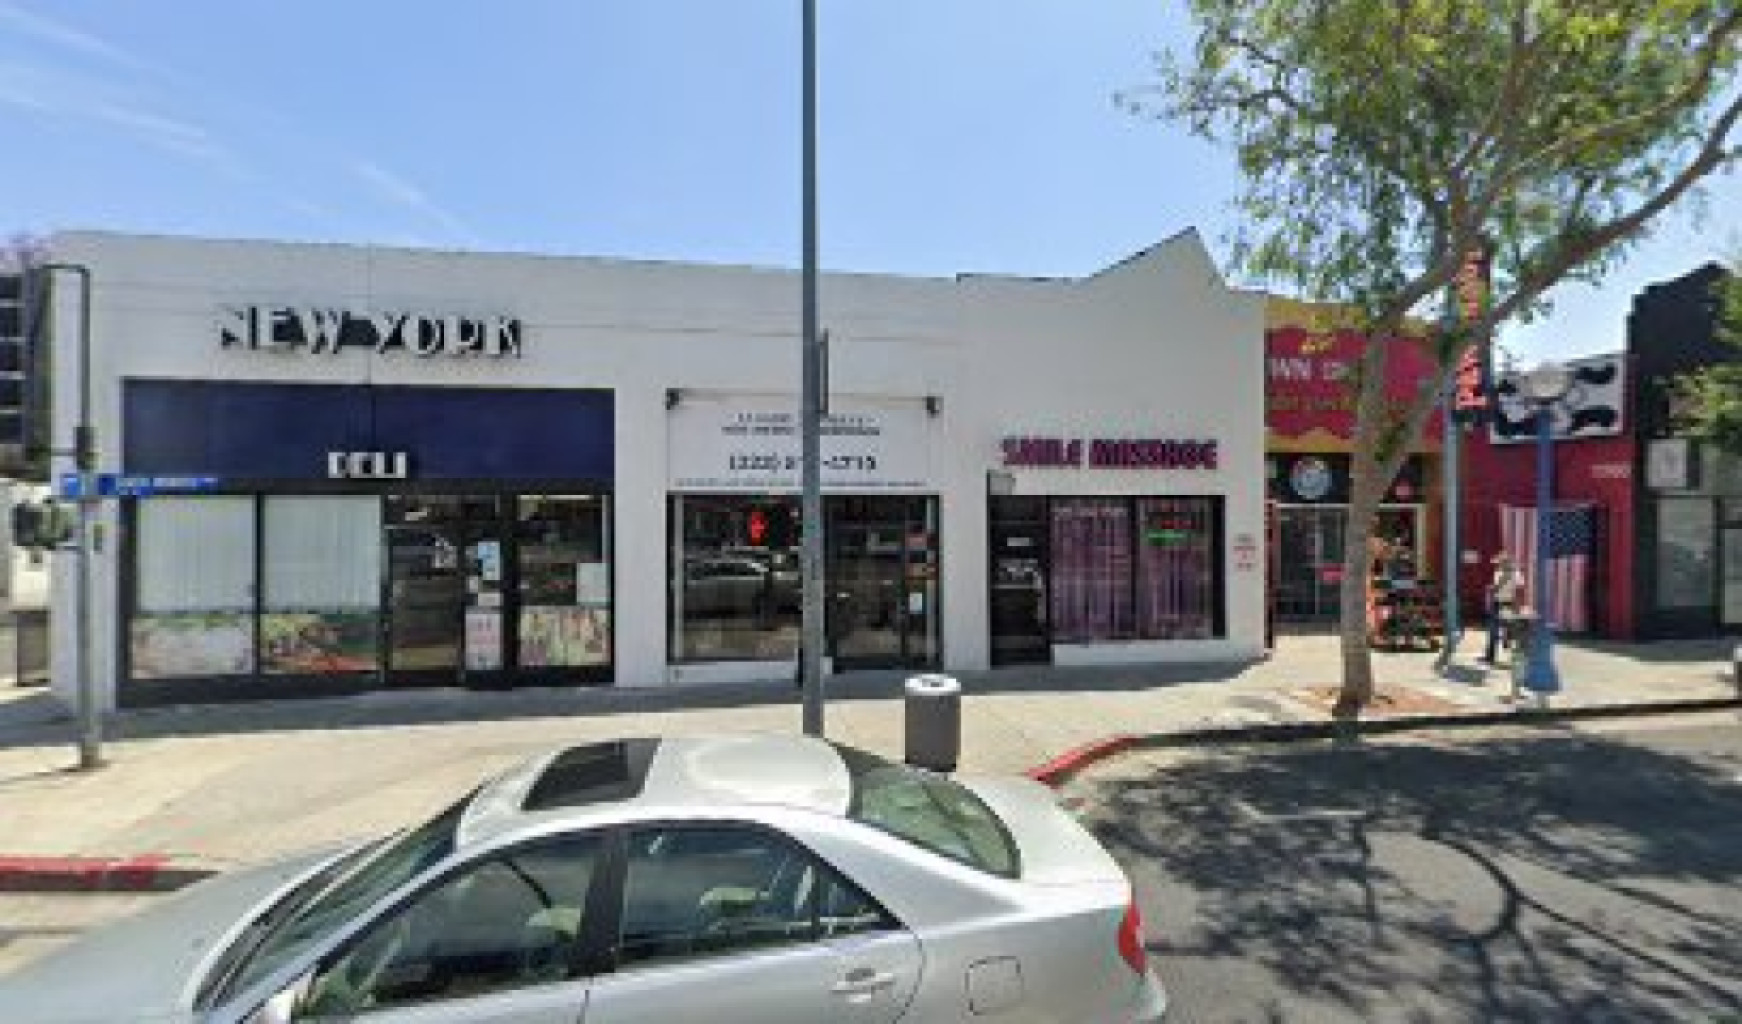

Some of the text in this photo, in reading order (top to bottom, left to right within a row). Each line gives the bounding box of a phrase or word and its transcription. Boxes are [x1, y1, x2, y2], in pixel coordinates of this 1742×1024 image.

[216, 306, 522, 358] NEW YORK
[328, 451, 407, 478] DELI
[1002, 438, 1218, 470] SMILE MASSAGE
